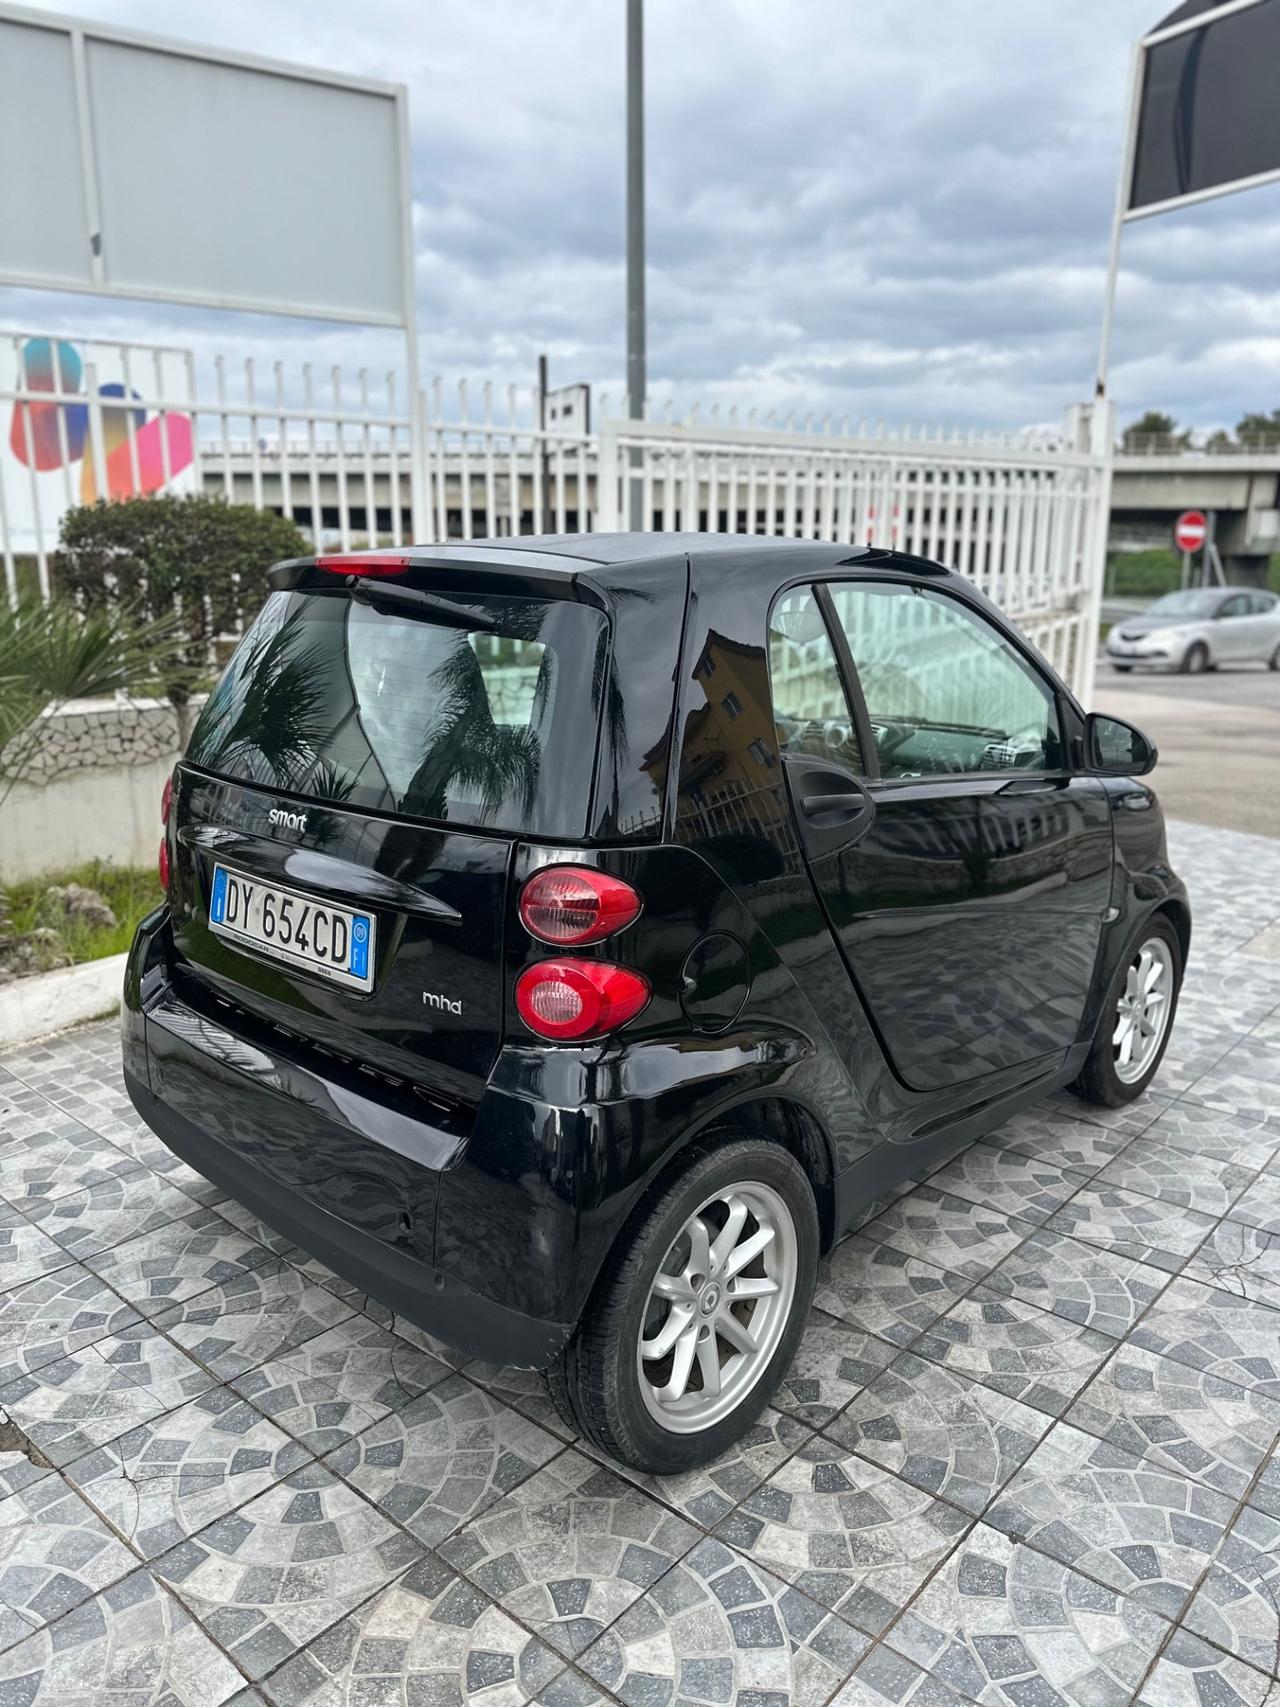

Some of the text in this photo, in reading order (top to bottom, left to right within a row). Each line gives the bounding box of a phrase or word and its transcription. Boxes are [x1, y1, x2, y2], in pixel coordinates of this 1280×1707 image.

[268, 808, 308, 833] smart
[226, 878, 348, 964] DY 654CD
[422, 991, 462, 1016] mhd
